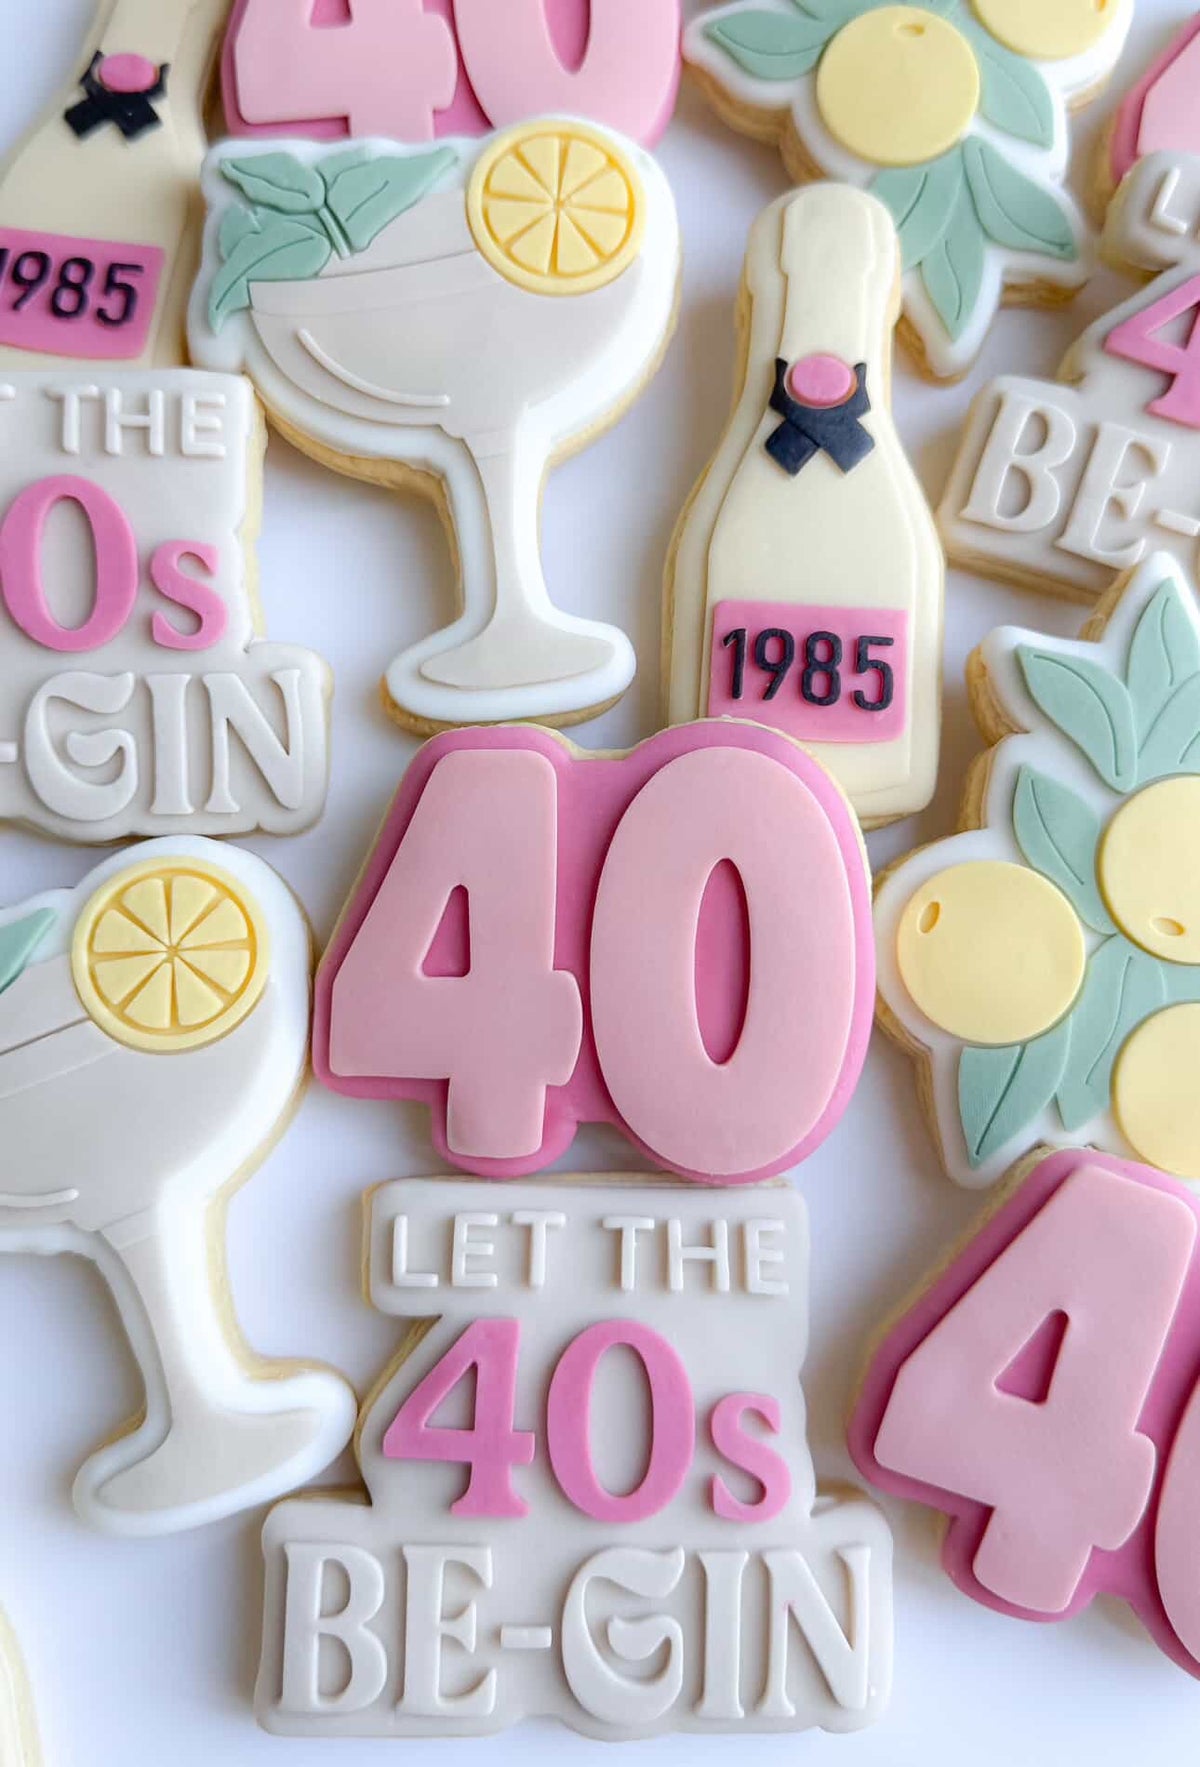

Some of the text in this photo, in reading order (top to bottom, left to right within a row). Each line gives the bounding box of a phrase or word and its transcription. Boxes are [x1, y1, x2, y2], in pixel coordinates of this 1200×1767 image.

[45, 384, 226, 457] THE
[723, 627, 894, 712] 1985
[329, 746, 857, 1175] 40
[392, 1210, 790, 1294] LET THE
[382, 1318, 792, 1523] 40s
[874, 1163, 1200, 1666] 4
[279, 1541, 872, 1724] BE-GIN
